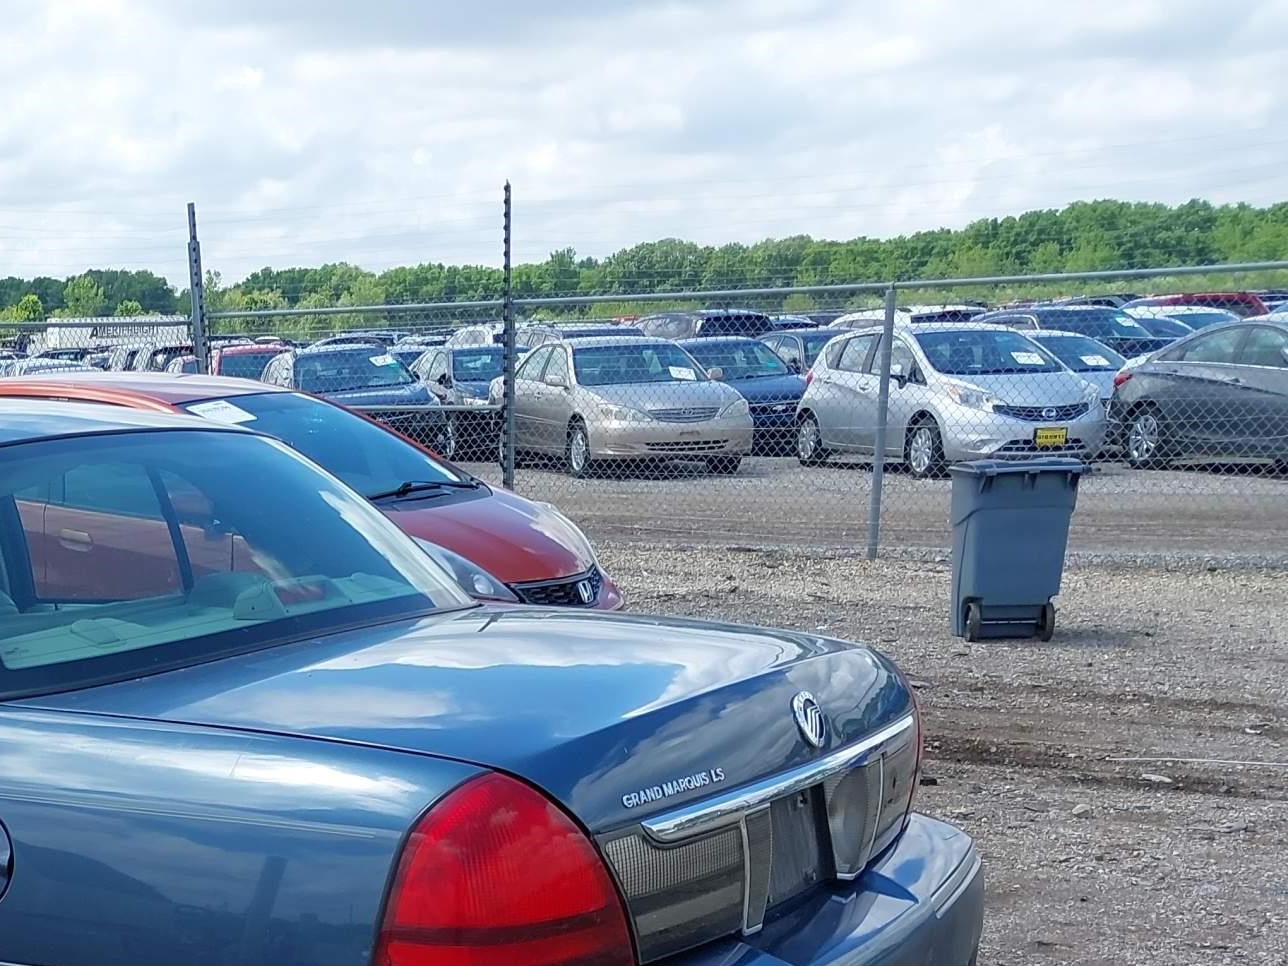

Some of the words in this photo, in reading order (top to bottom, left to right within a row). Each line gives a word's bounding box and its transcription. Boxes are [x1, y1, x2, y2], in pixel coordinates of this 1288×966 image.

[623, 787, 662, 807] GRAND
[662, 772, 709, 796] MARQUIS
[711, 768, 725, 782] LS
